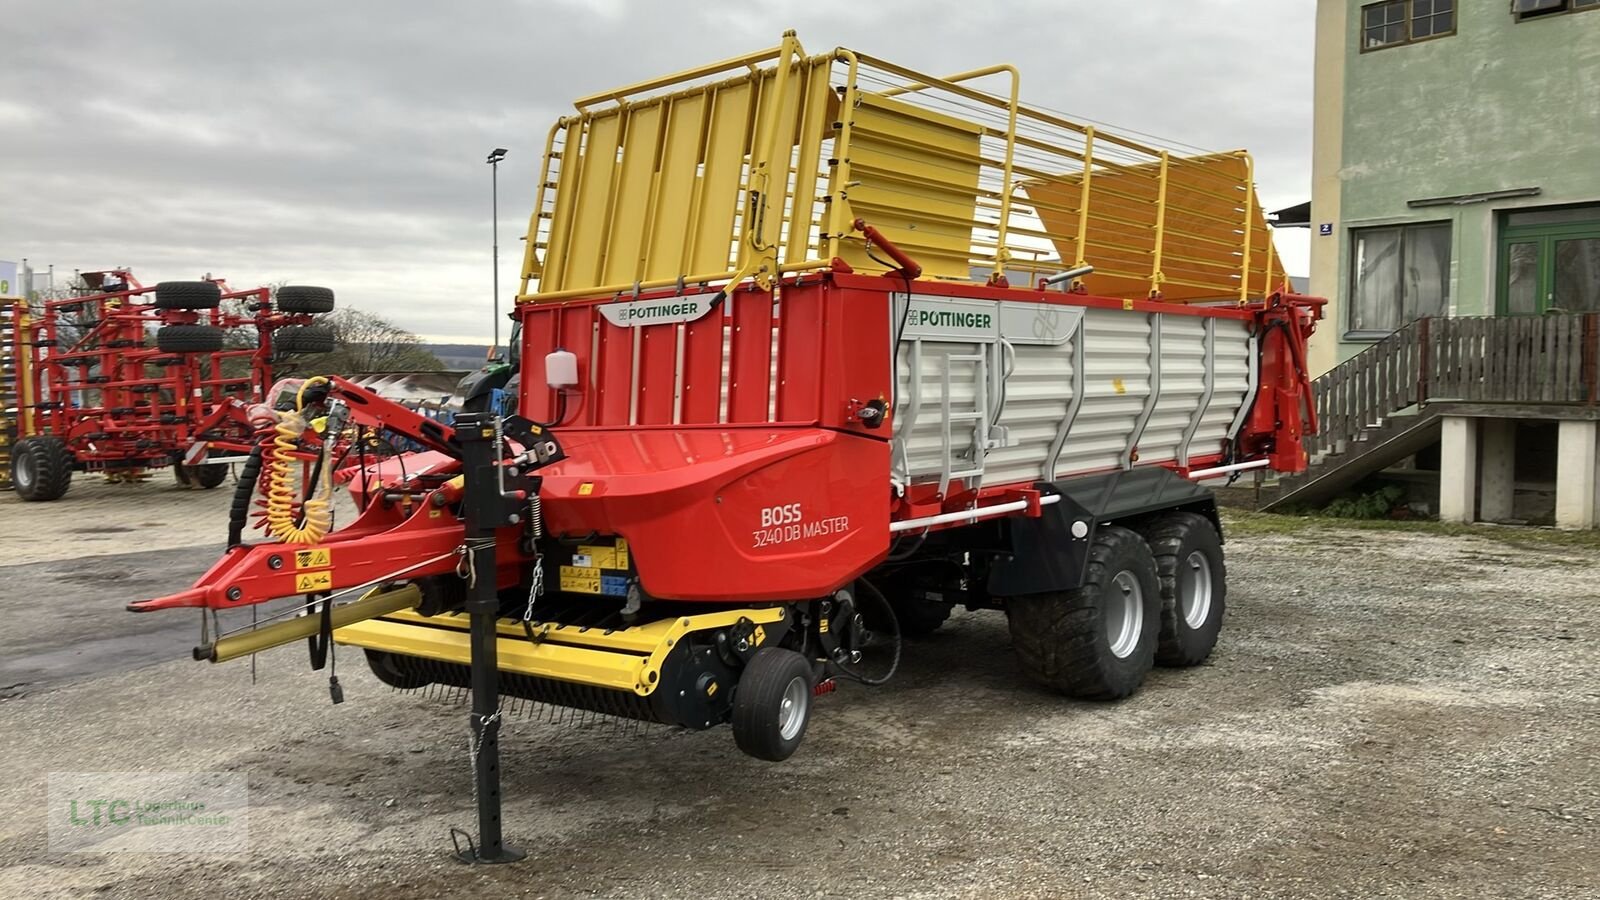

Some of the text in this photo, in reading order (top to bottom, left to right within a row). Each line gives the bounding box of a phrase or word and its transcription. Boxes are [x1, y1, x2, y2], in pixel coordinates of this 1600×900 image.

[761, 503, 802, 528] BOSS
[752, 516, 849, 549] 3240 DB MASTER
